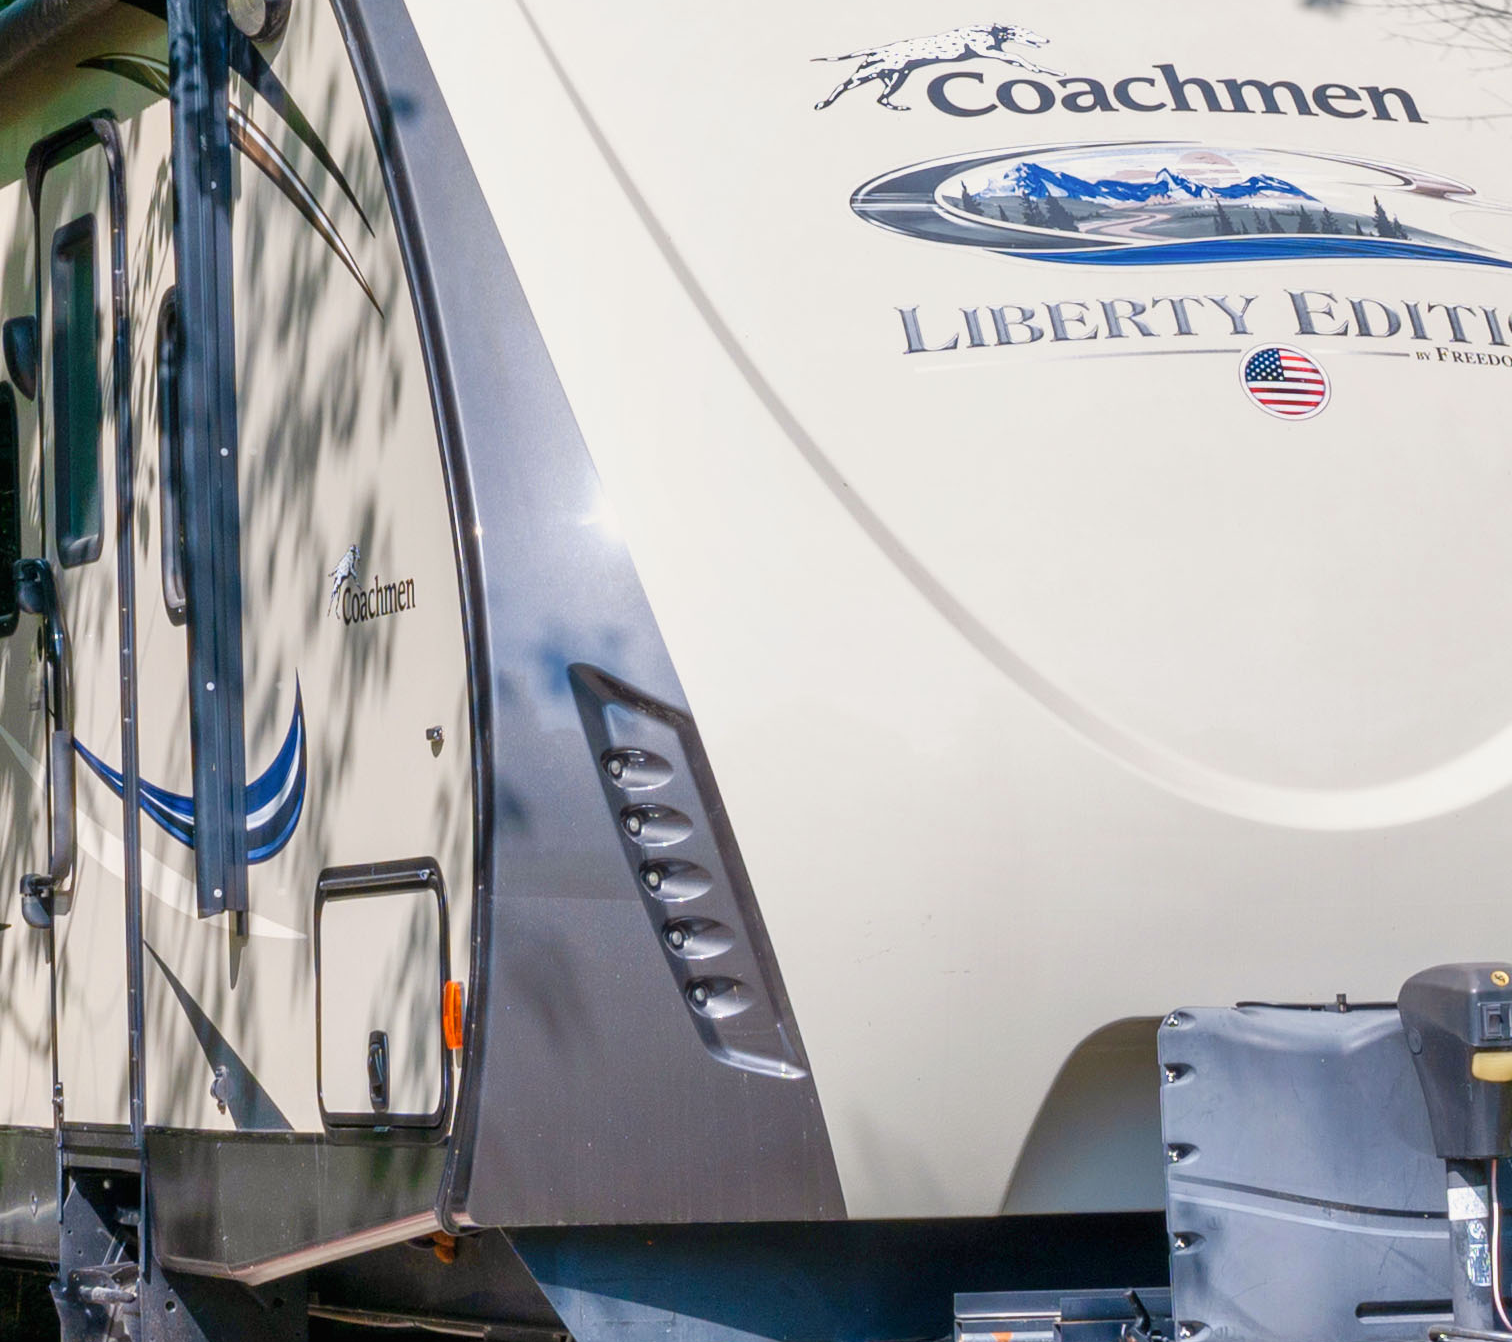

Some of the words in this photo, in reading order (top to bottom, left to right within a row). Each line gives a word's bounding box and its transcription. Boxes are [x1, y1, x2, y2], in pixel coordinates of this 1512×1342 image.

[926, 63, 1429, 125] Coachmen
[893, 294, 1259, 355] LIBERTY
[1416, 351, 1431, 361] BY
[342, 574, 416, 627] Coachmen
